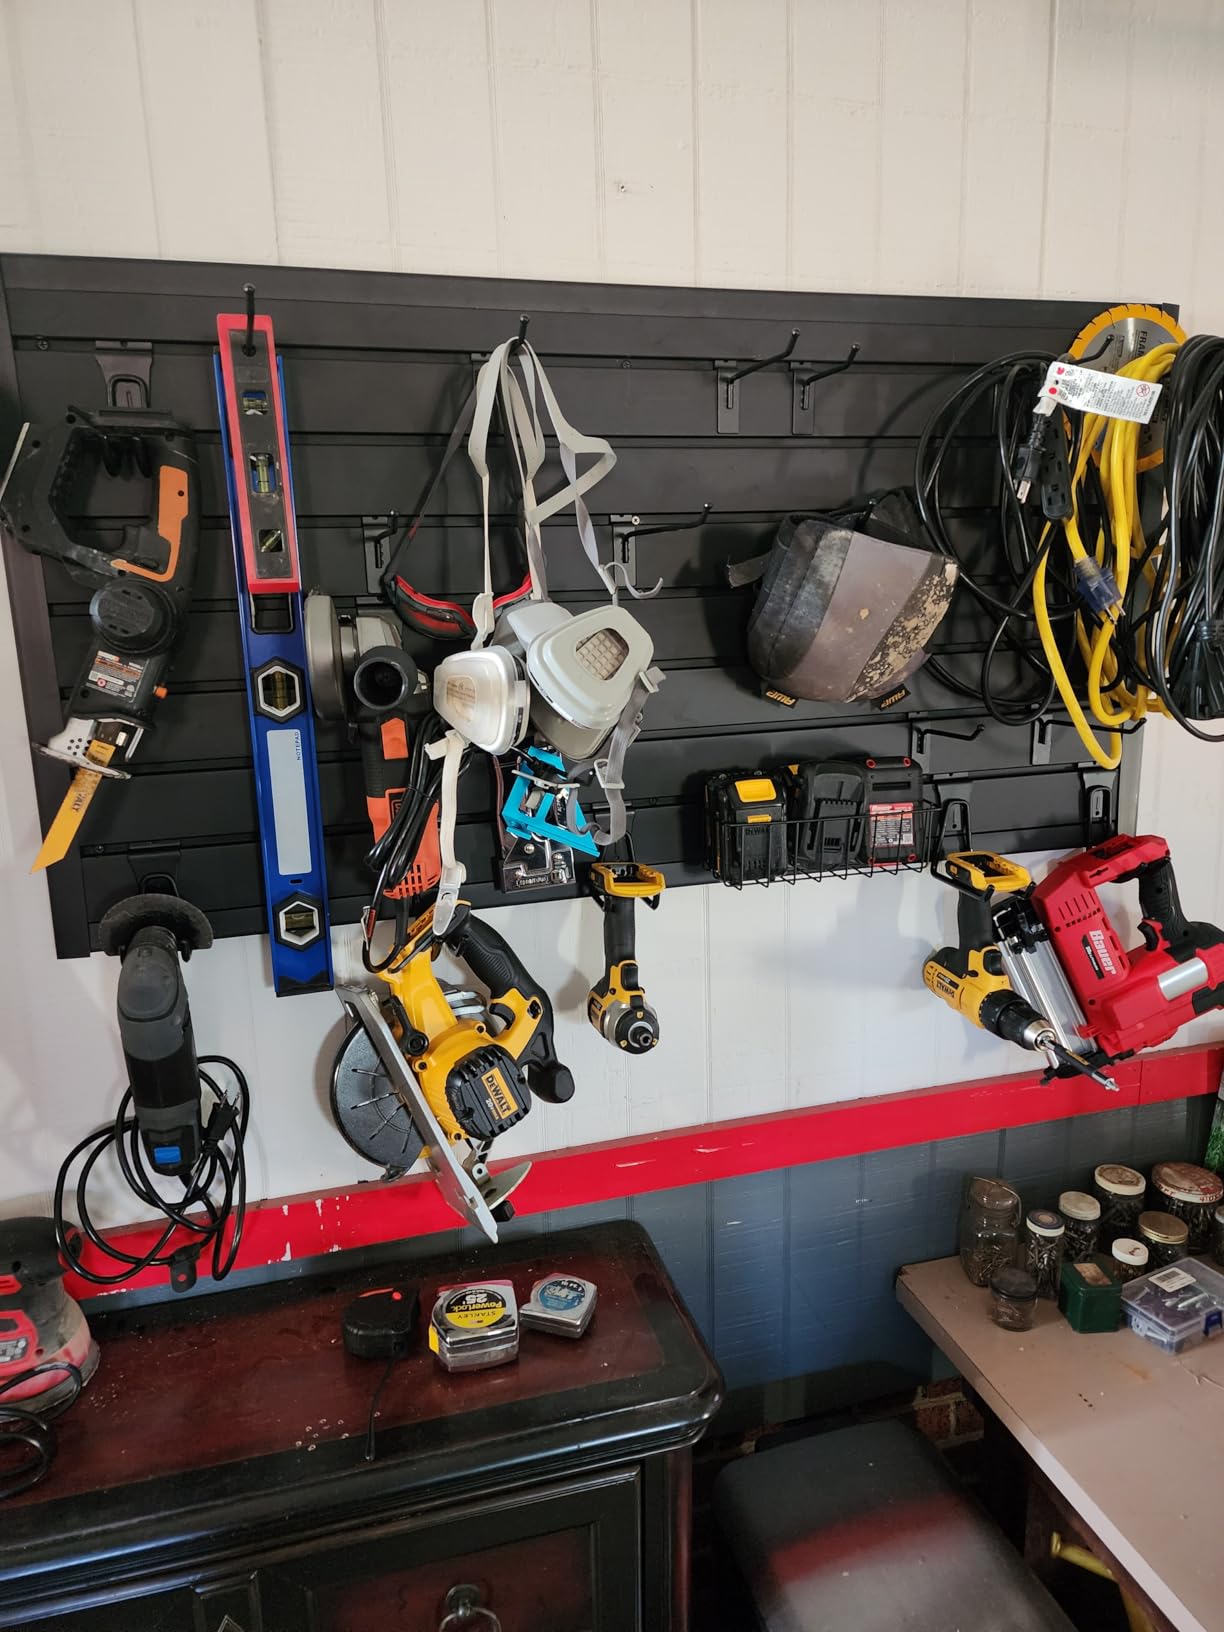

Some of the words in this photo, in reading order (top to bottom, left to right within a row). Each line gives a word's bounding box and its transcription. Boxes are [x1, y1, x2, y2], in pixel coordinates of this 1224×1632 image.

[766, 690, 796, 706] AWP
[880, 689, 906, 708] AWP
[1089, 929, 1117, 976] Bauer
[450, 1301, 503, 1312] PowerLock
[457, 1311, 497, 1320] STANLEY
